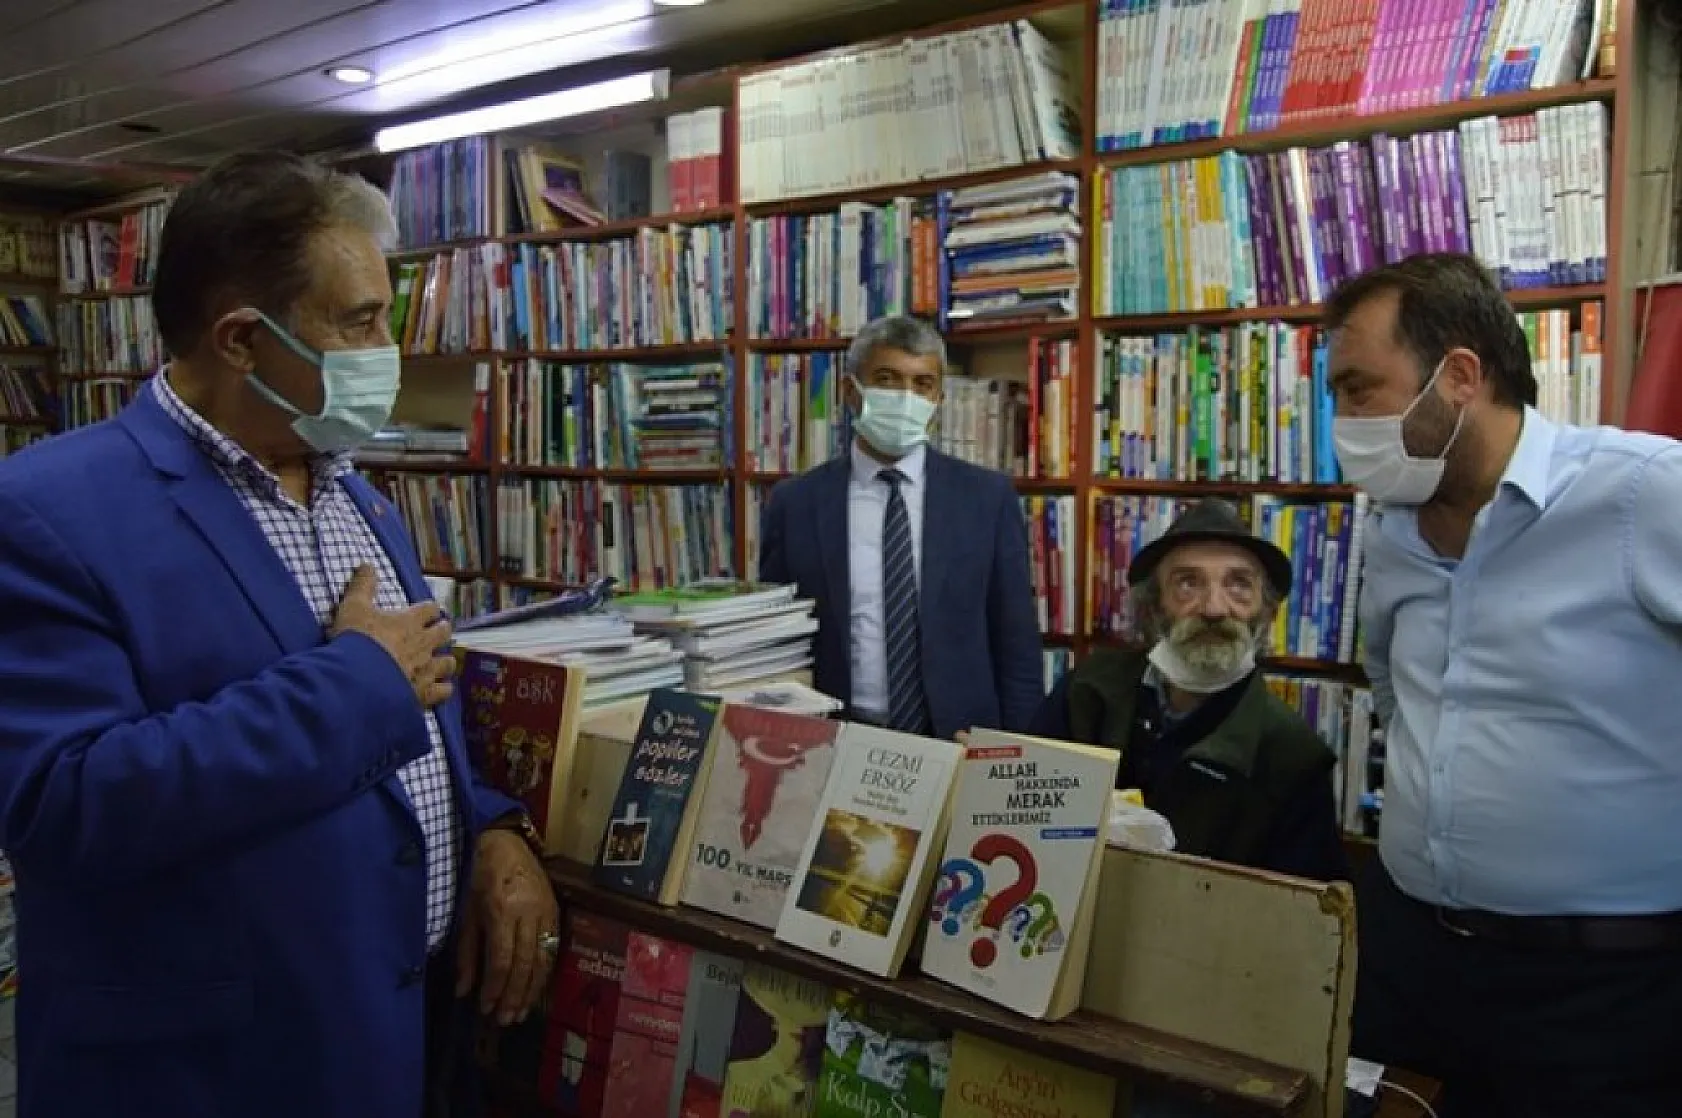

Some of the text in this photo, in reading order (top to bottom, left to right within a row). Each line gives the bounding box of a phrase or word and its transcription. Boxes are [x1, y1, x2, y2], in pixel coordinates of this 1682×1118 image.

[987, 762, 1039, 780] ALLAH
[1015, 776, 1081, 791] HAKKINDA
[1006, 792, 1065, 809] MERAK
